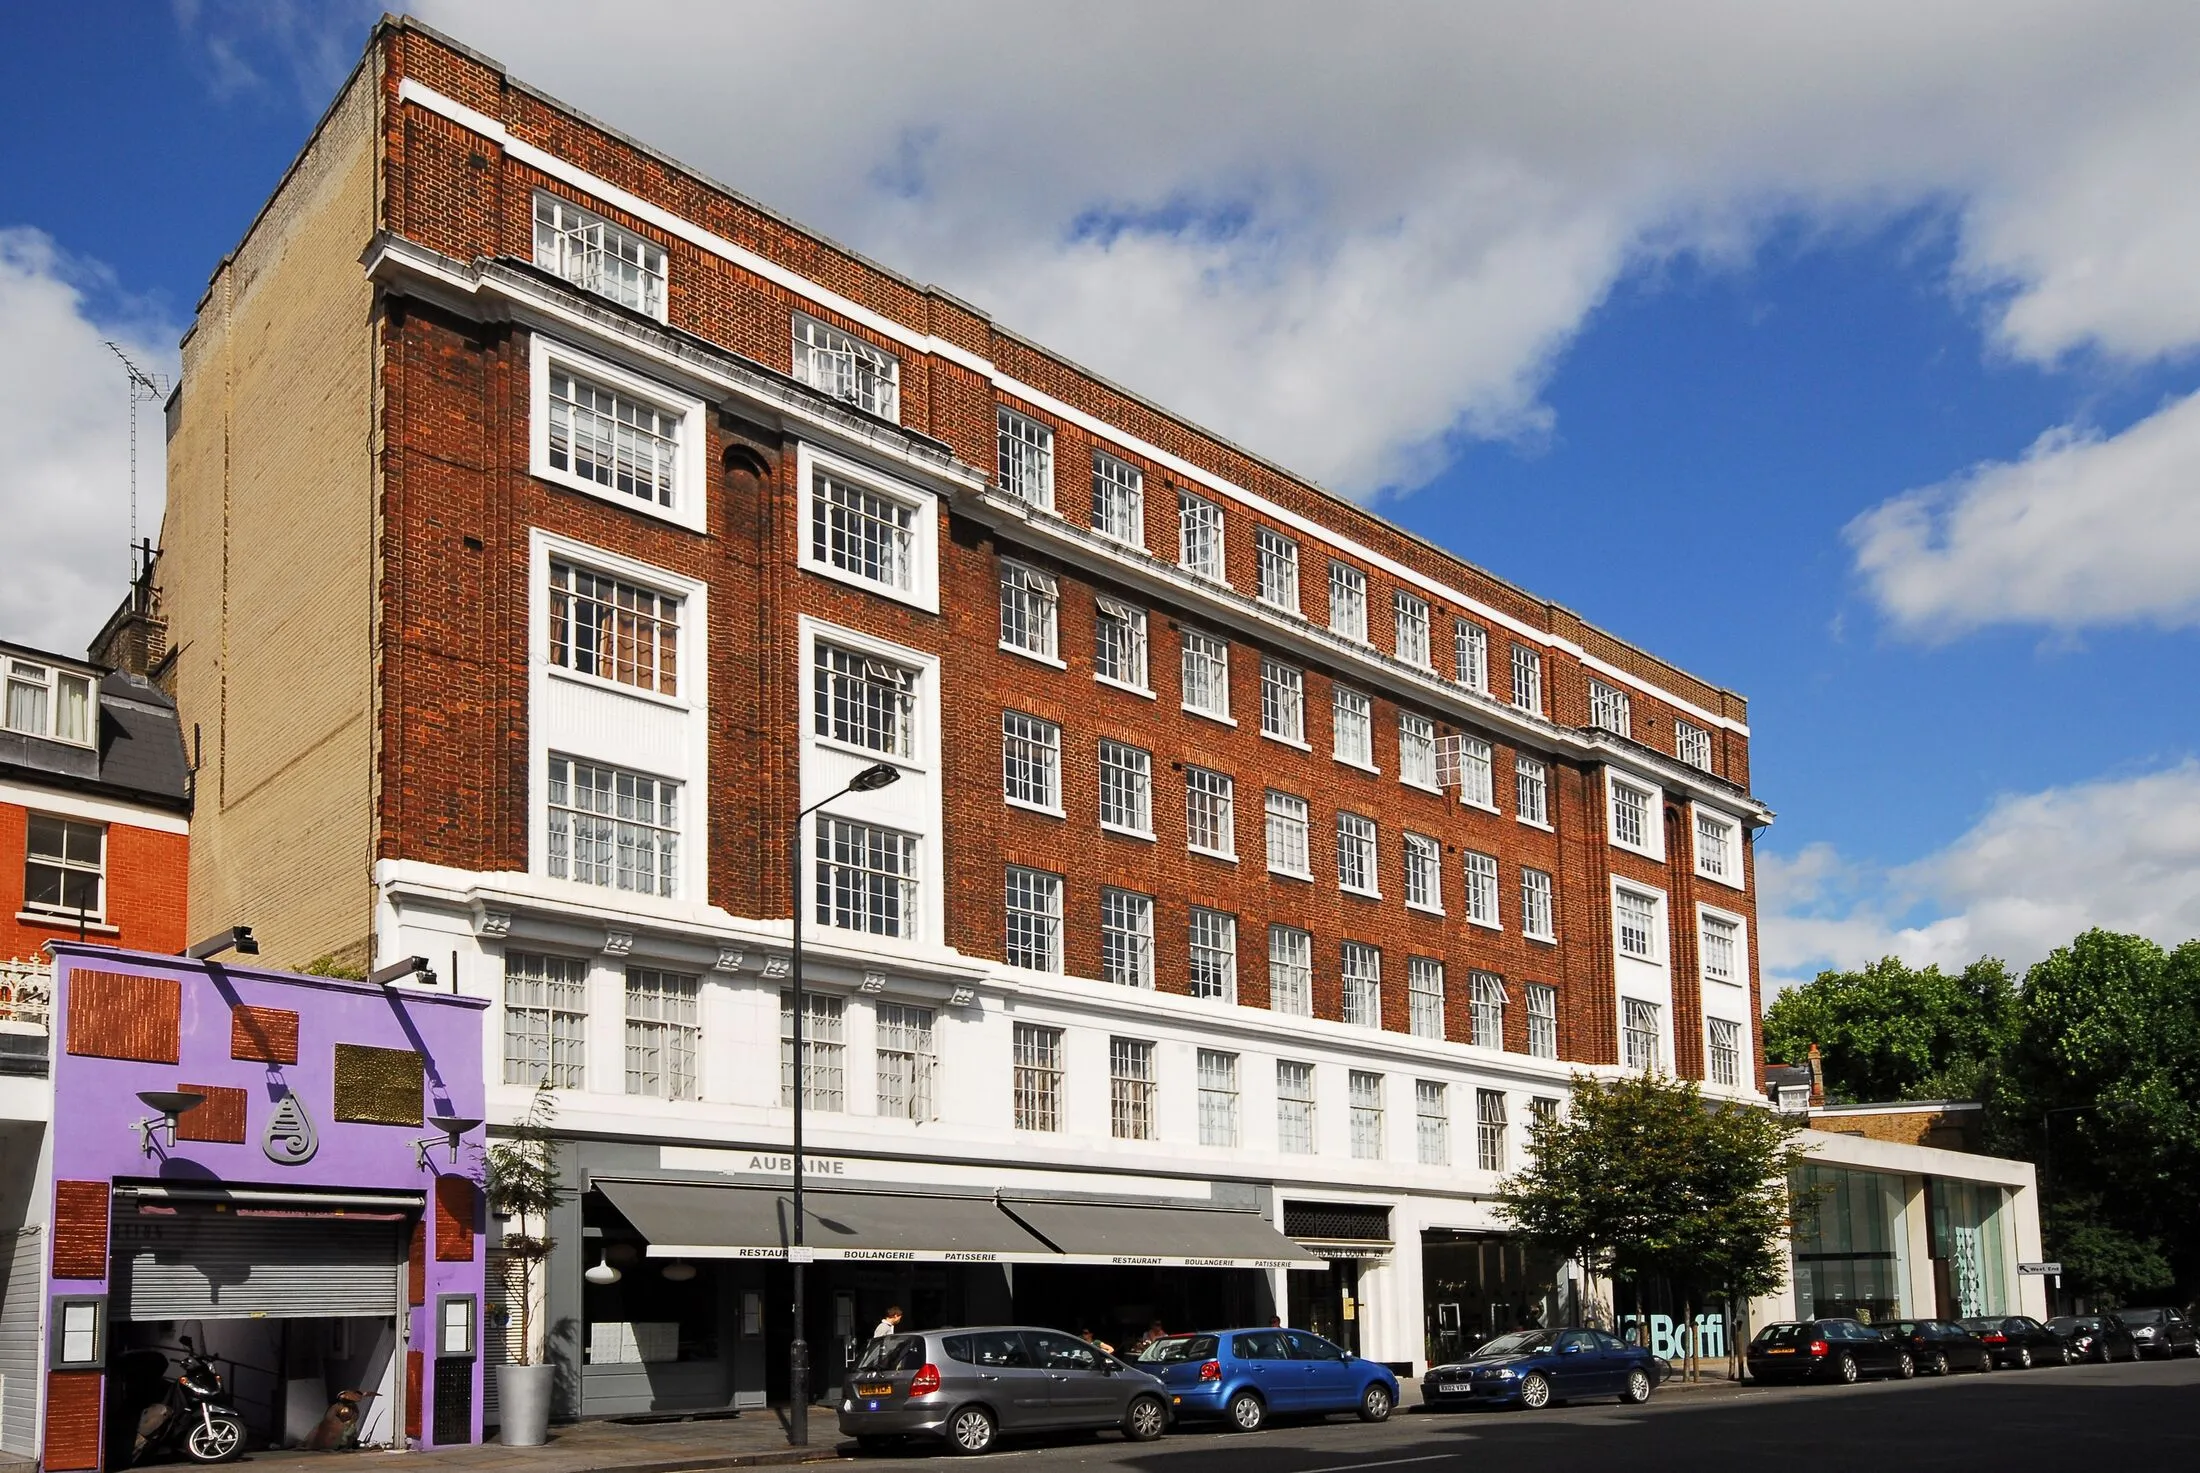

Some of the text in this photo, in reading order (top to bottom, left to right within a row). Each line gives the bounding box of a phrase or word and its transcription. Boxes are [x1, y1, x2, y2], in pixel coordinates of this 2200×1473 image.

[844, 1251, 915, 1259] BOULANGERIE
[945, 1253, 996, 1261] PATISSERIE
[1112, 1257, 1163, 1265] RESTAURANT
[1650, 1314, 1724, 1360] Boffi
